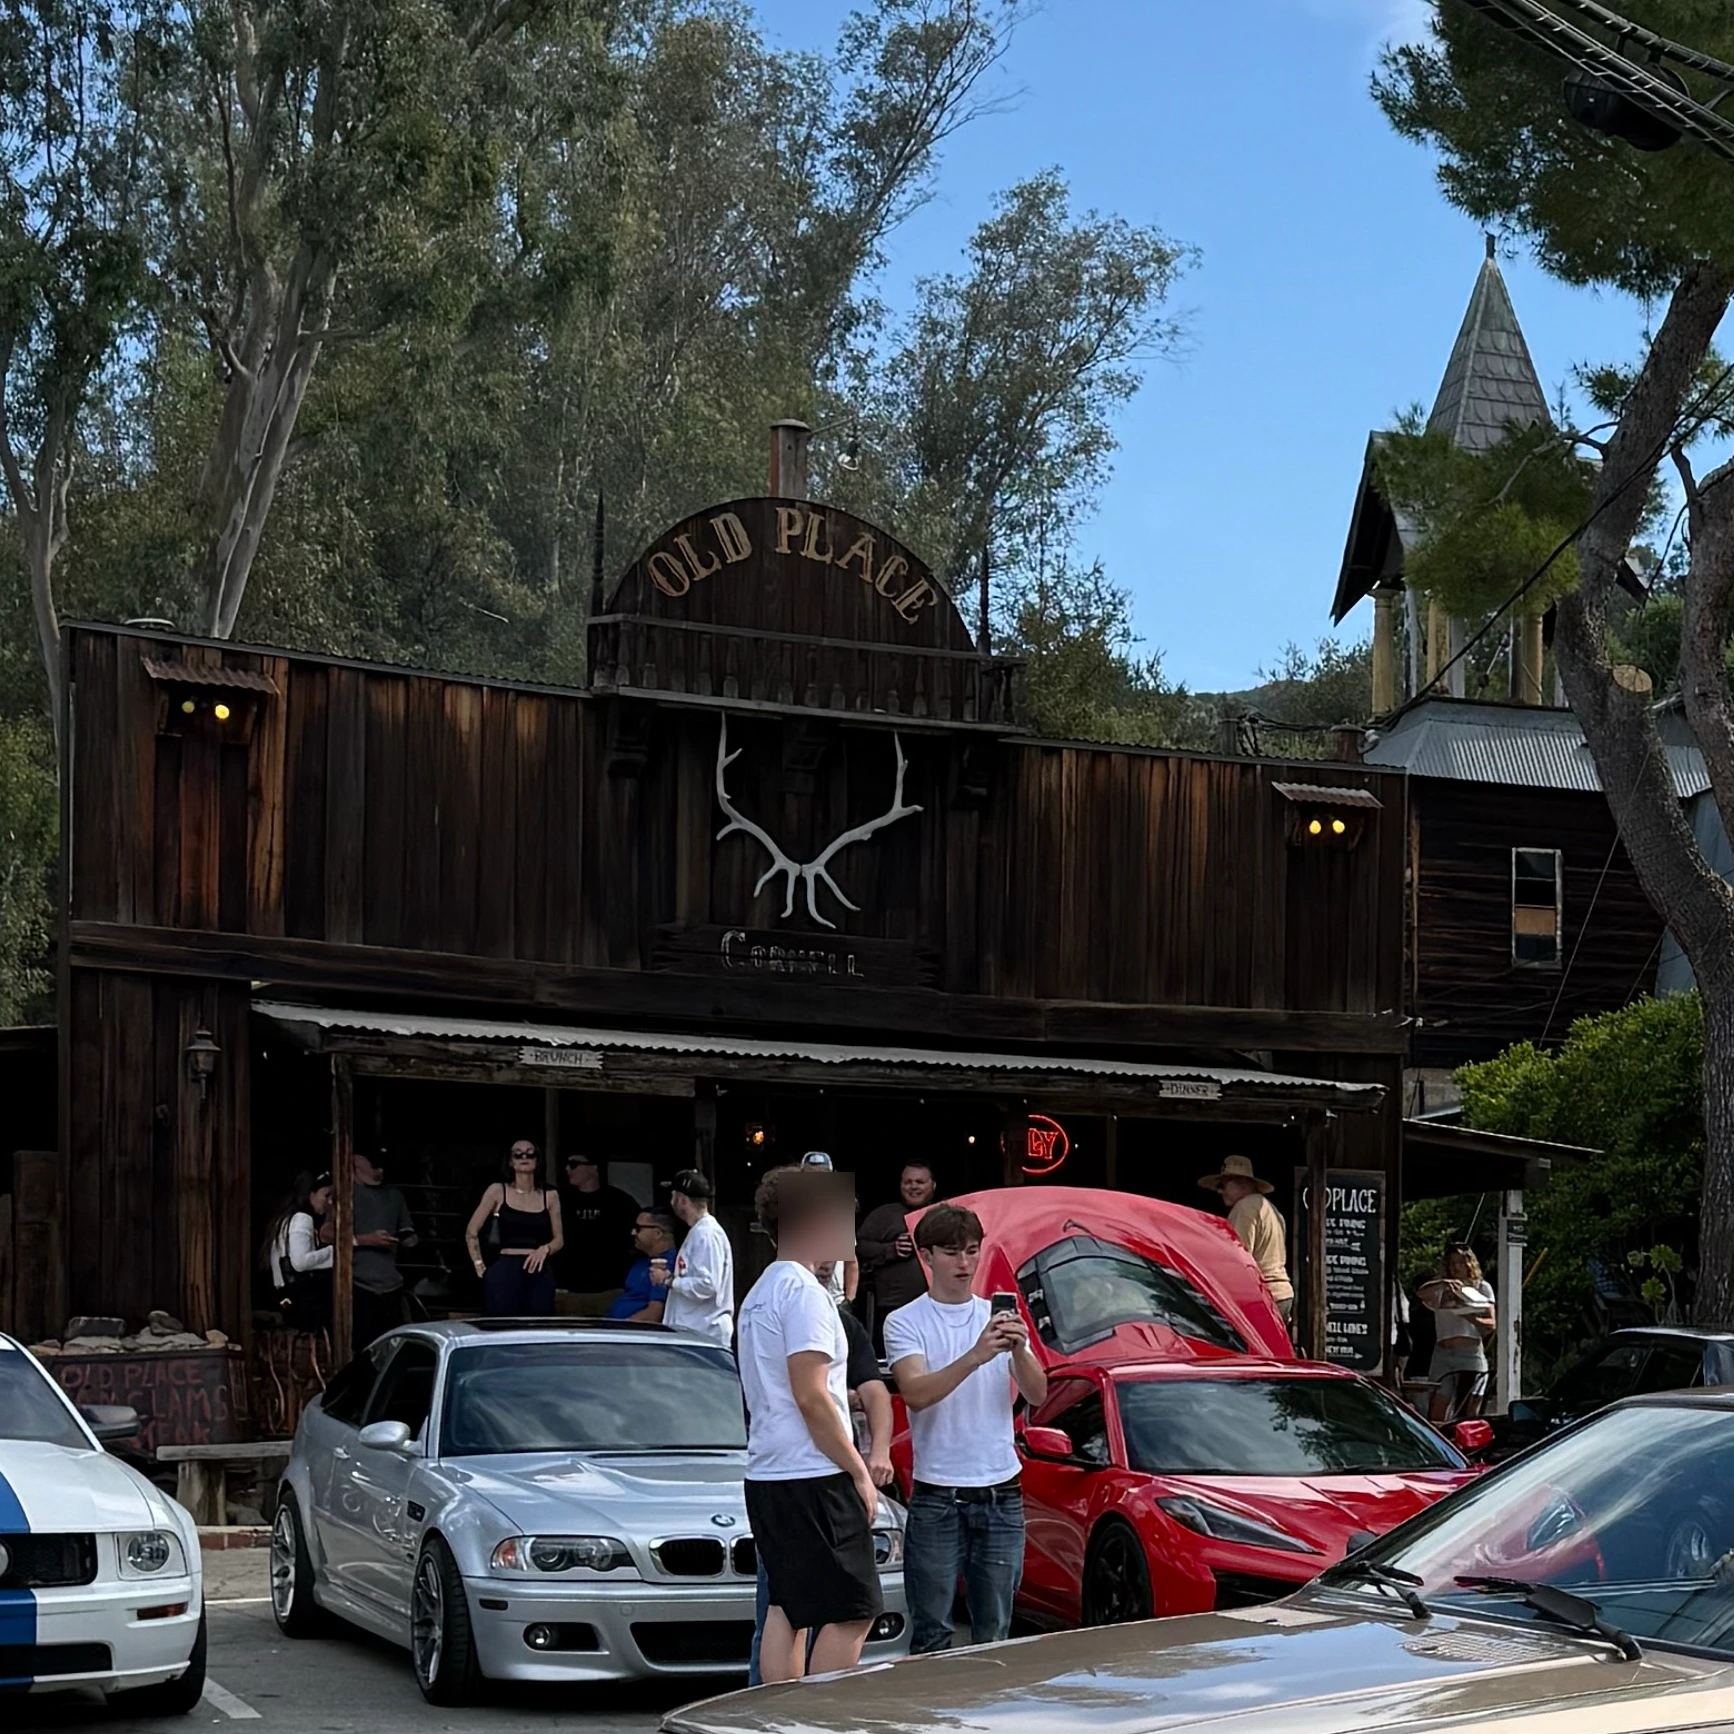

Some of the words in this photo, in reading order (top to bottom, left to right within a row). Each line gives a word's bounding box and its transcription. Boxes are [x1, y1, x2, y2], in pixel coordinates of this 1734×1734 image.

[648, 511, 752, 597] OLD
[774, 506, 938, 625] PLACE
[1332, 1187, 1378, 1214] PLACE
[61, 1364, 113, 1389] OLD
[124, 1360, 204, 1388] PLACE
